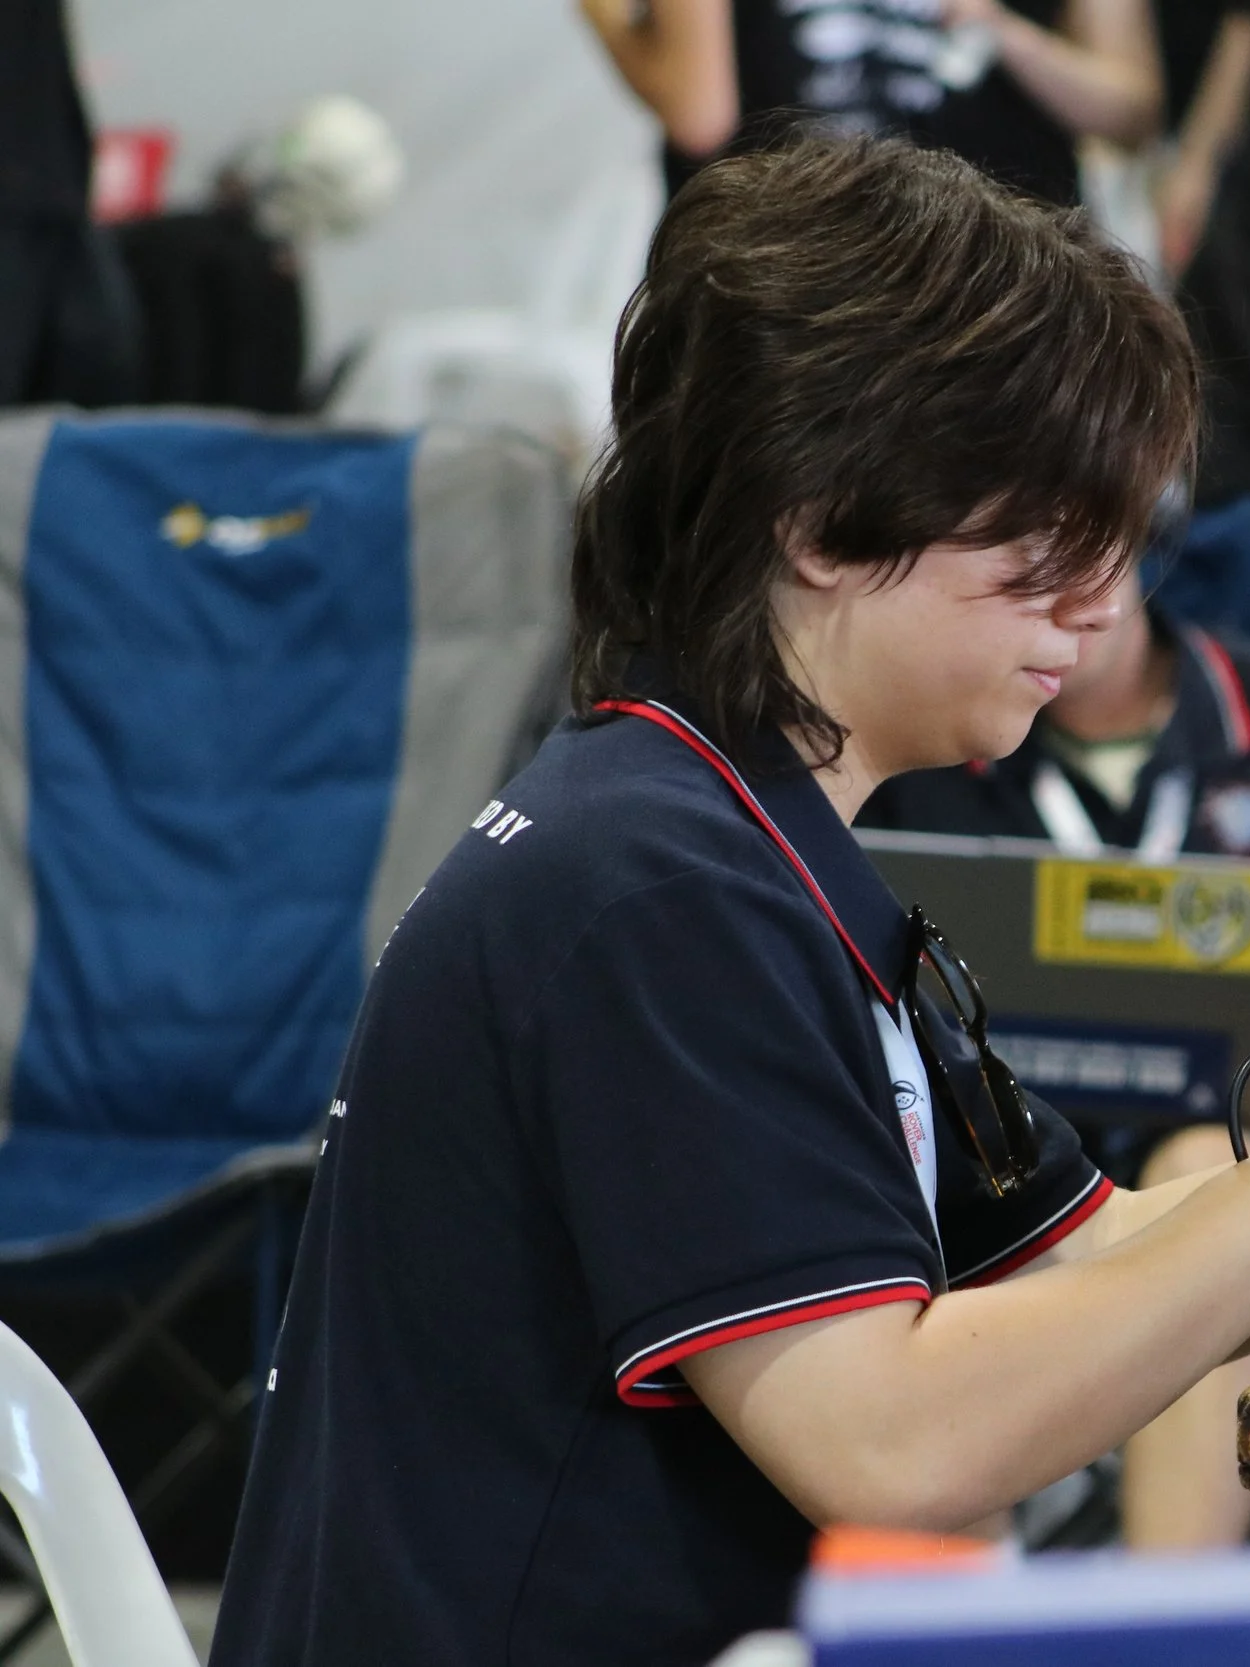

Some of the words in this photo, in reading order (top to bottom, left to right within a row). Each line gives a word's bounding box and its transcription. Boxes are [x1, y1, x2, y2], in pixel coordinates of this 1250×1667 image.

[486, 809, 534, 845] BY
[900, 1115, 922, 1166] CHALLENGE
[906, 1112, 923, 1141] ROVER
